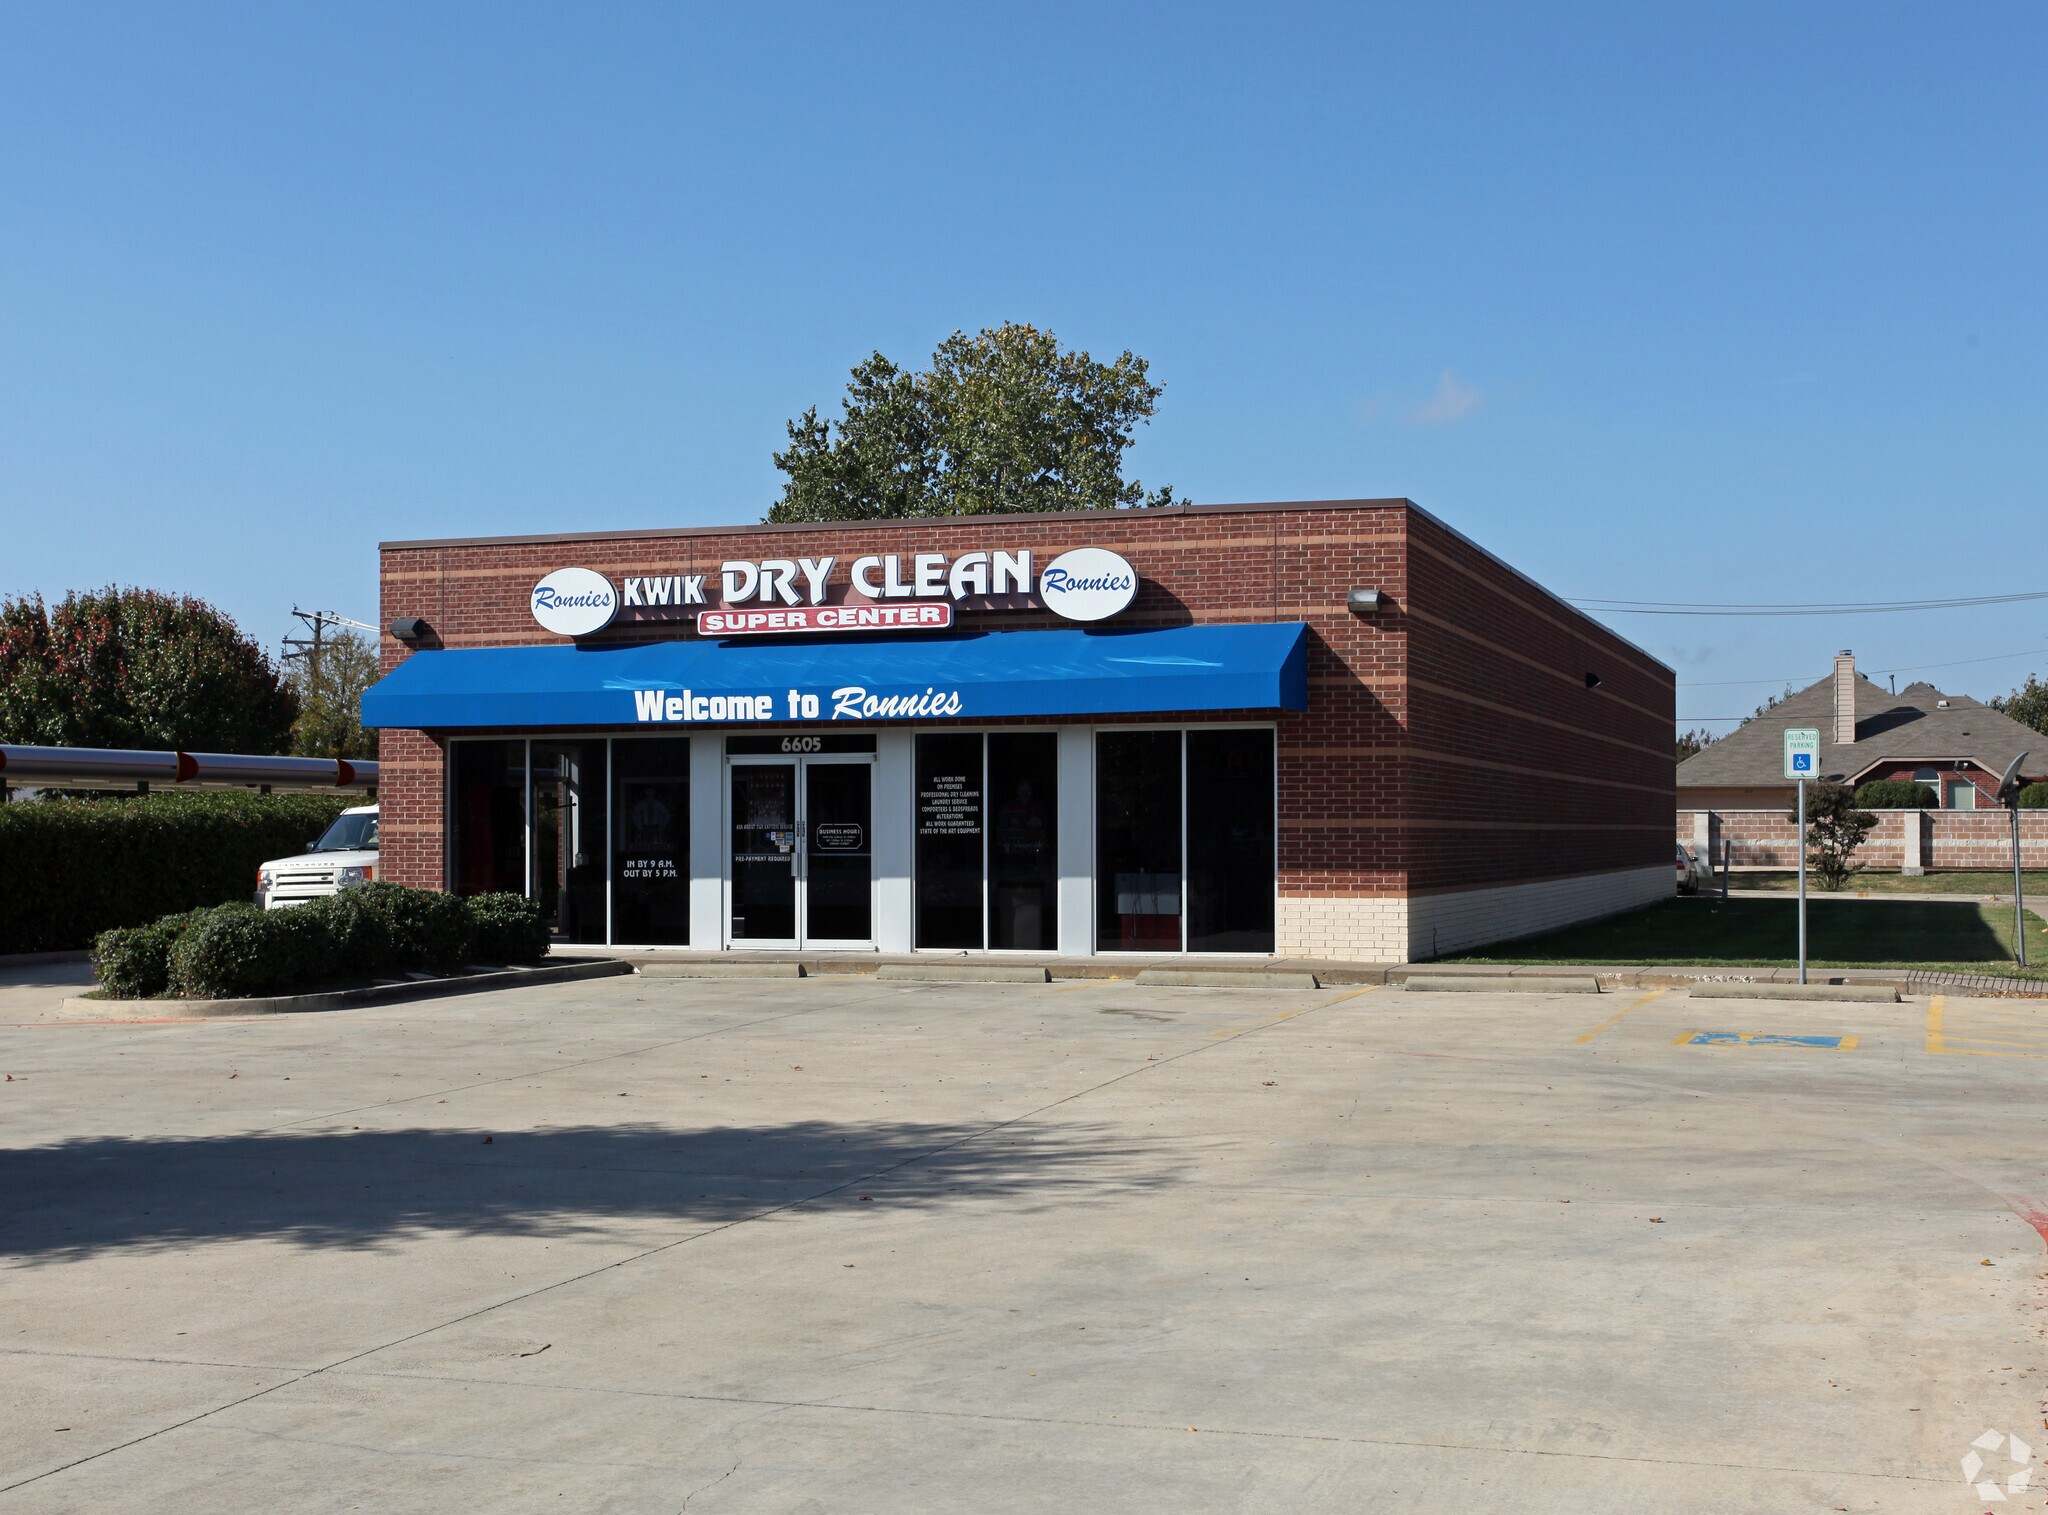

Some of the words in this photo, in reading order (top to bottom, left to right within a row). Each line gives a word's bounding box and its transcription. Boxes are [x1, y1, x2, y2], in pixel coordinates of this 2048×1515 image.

[624, 575, 706, 607] KWIK
[721, 556, 836, 607] DRY
[851, 549, 1032, 600] CLEAN
[1044, 568, 1132, 594] Ronnies
[534, 586, 612, 611] Ronnies
[705, 612, 807, 630] SUPER
[816, 607, 941, 626] CENTER
[634, 689, 773, 722] Welcome
[787, 689, 819, 719] to
[831, 686, 963, 720] Ronnies
[781, 737, 821, 752] 6605
[638, 860, 648, 868] BY
[658, 860, 674, 868] A.M.
